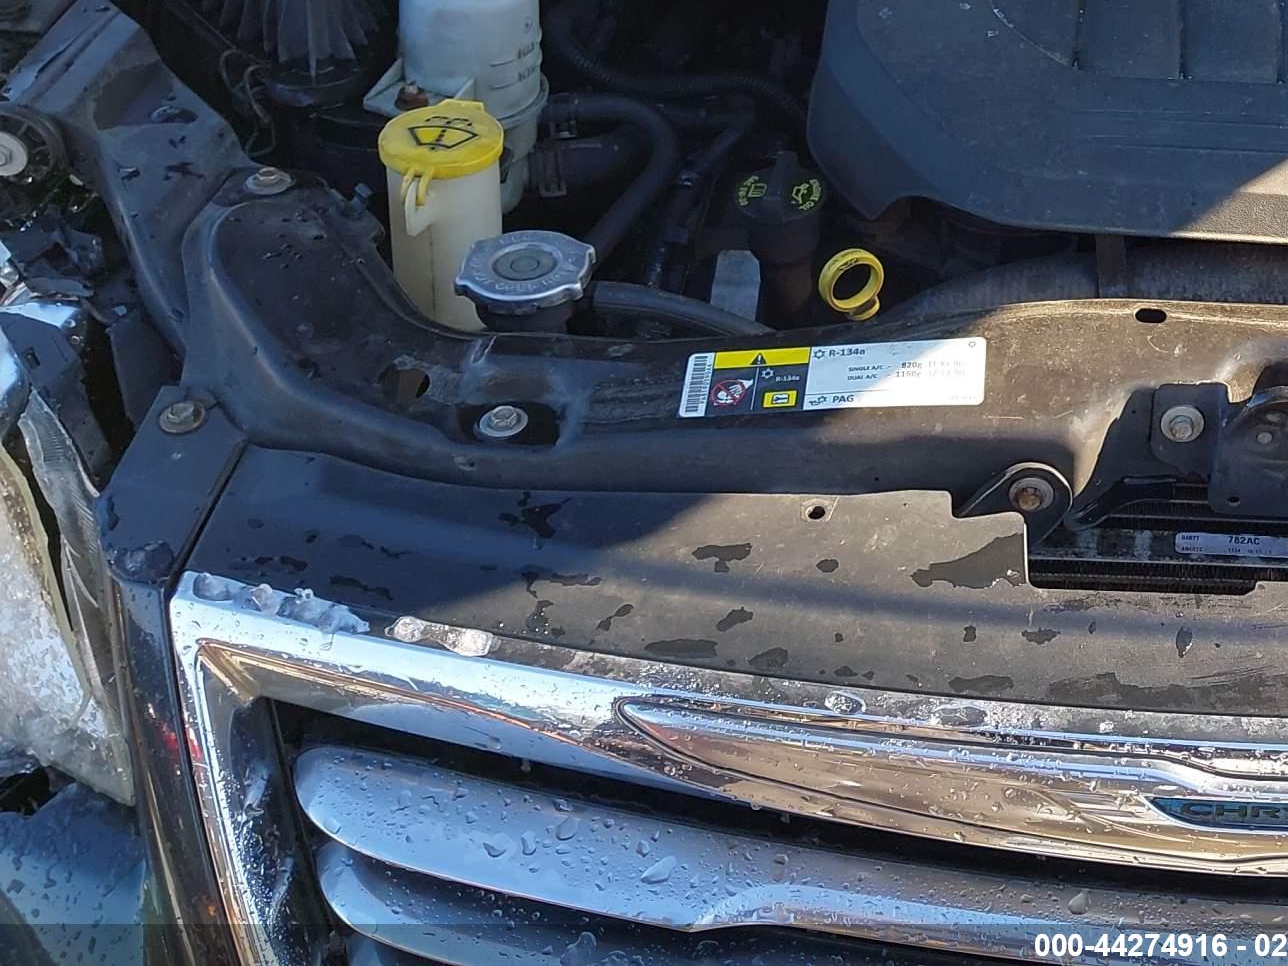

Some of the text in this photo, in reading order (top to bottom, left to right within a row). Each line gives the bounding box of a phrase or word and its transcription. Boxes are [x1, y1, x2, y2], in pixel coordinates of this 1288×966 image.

[828, 347, 866, 358] R-134a
[832, 394, 855, 403] PAG
[1227, 535, 1261, 546] 782AC
